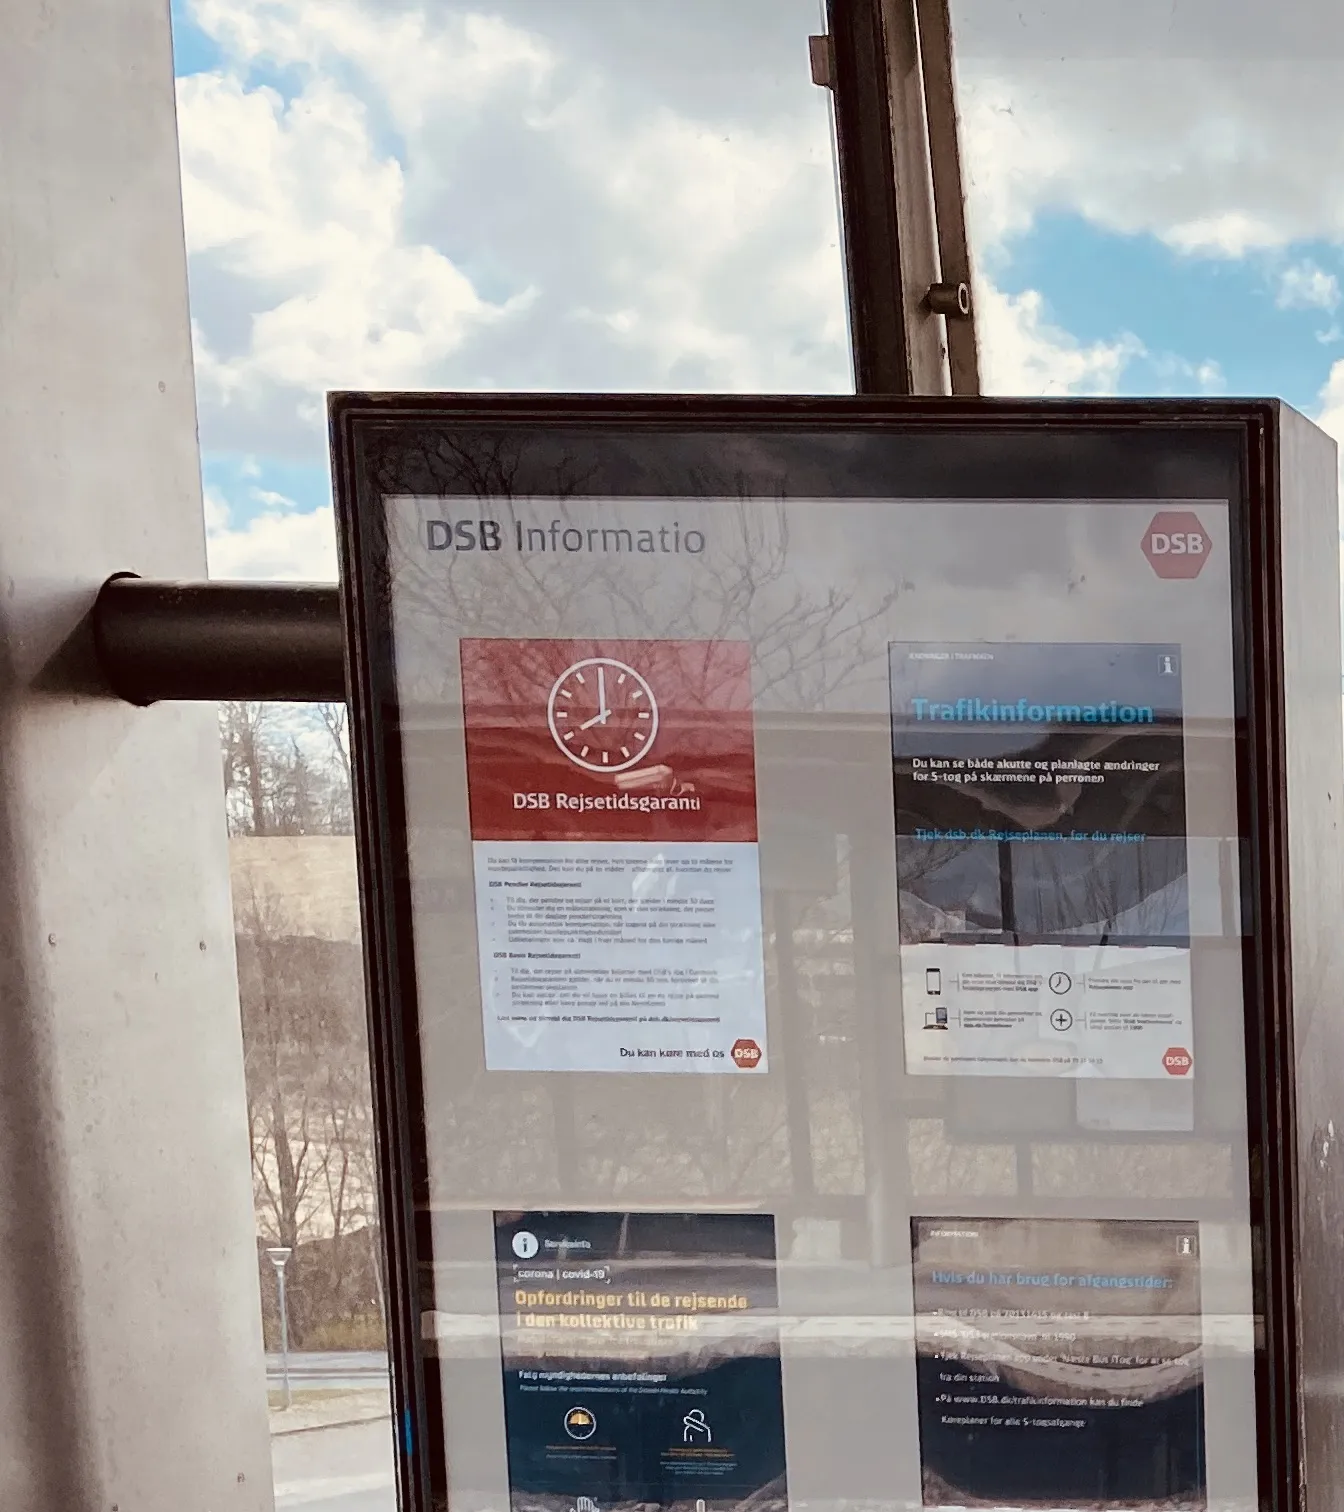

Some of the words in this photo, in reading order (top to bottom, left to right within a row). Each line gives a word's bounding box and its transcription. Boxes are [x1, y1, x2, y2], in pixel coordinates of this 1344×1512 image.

[426, 519, 501, 551] DSB
[516, 518, 706, 554] Informatio
[1151, 533, 1204, 554] DSB
[911, 697, 1154, 724] Trafikinformation
[913, 758, 928, 770] Du
[930, 758, 950, 770] kan
[953, 760, 965, 770] se
[967, 758, 994, 770] både
[996, 759, 1032, 770] akutte
[1034, 760, 1048, 772] og
[1051, 759, 1101, 772] planlagte
[1103, 759, 1160, 773] ændringer
[913, 771, 929, 782] for
[964, 771, 978, 784] på
[980, 772, 1036, 783] skærmene
[1039, 771, 1053, 784] på
[513, 793, 550, 809] DSB
[556, 793, 700, 812] Rejsetidsgaranti
[620, 1048, 635, 1058] Du
[734, 1049, 759, 1060] DSB
[1165, 1056, 1190, 1067] DSB
[518, 1270, 554, 1280] corona
[562, 1269, 606, 1280] covid-19
[932, 1271, 962, 1284] Hvis
[967, 1271, 984, 1284] du
[989, 1271, 1011, 1285] har
[1016, 1272, 1049, 1287] brug
[1053, 1273, 1075, 1287] for
[515, 1290, 623, 1309] Opfordringer
[628, 1291, 647, 1307] til
[650, 1291, 671, 1308] de
[675, 1292, 748, 1311] rejsende
[516, 1312, 521, 1328] i
[525, 1313, 556, 1328] den
[559, 1313, 647, 1329] kollektive
[650, 1314, 699, 1331] trafik
